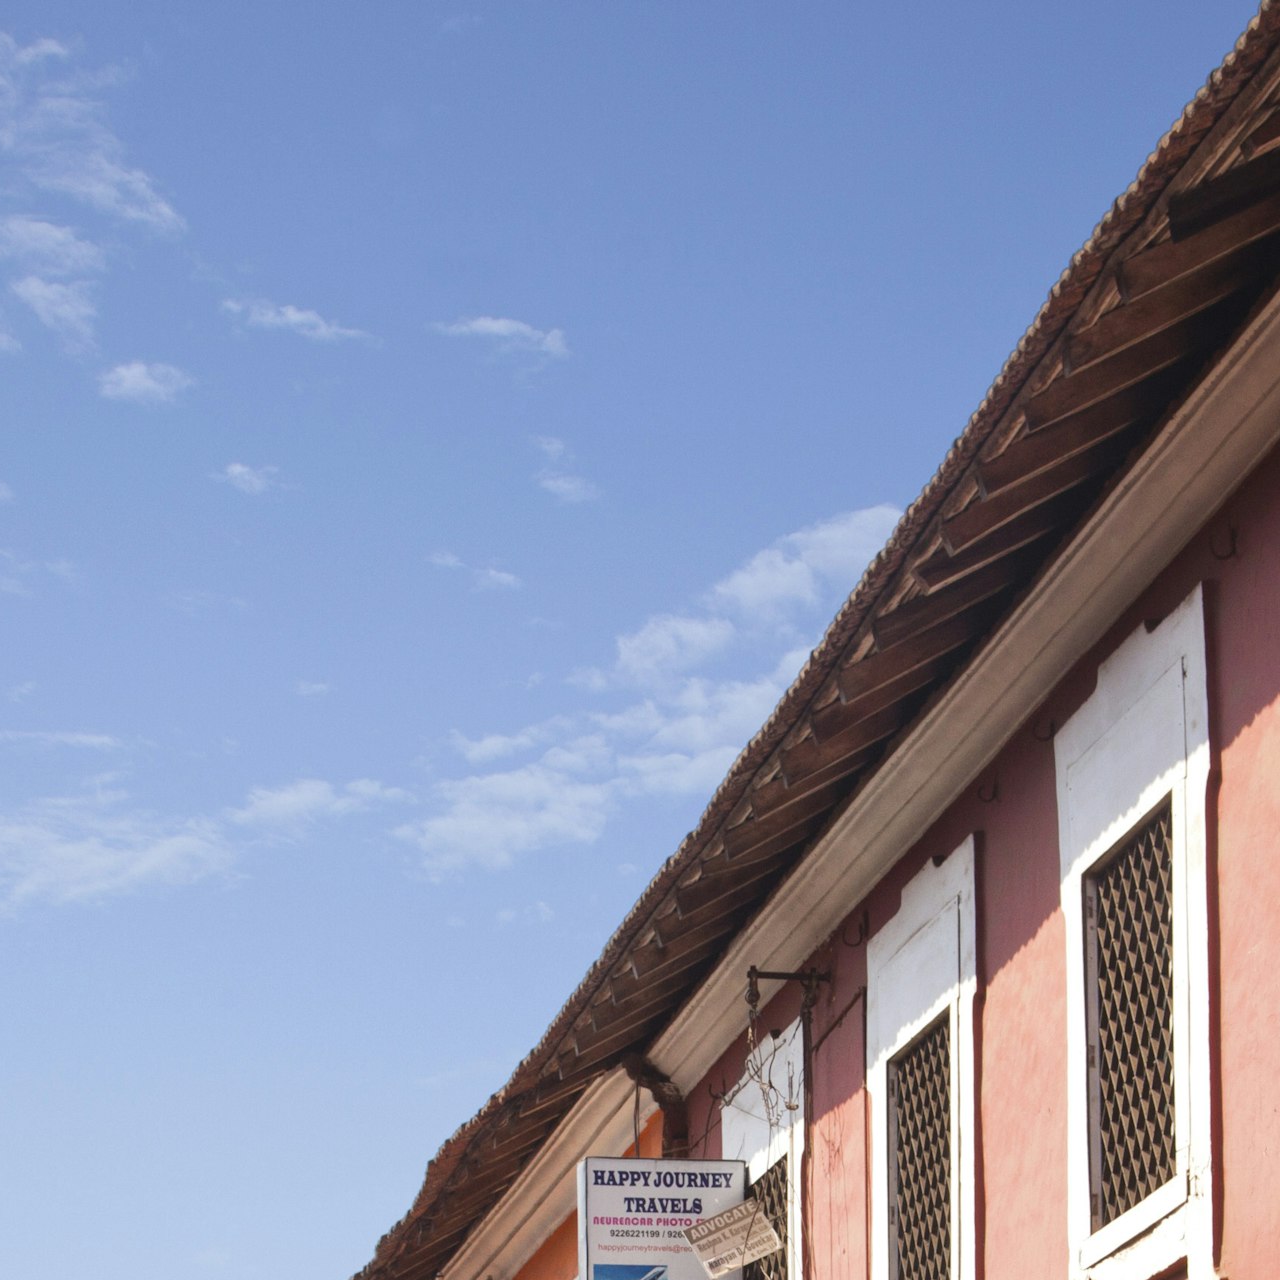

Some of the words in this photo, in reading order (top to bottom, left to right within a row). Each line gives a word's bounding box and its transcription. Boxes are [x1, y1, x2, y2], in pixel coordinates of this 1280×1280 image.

[593, 1170, 652, 1187] HAPPY
[654, 1171, 733, 1189] JOURNEY
[624, 1197, 703, 1214] TRAVELS
[593, 1217, 654, 1227] NEURENCAR
[656, 1217, 693, 1227] PHOTO
[690, 1200, 757, 1240] ADVOCATE
[609, 1229, 661, 1238] 9226221199
